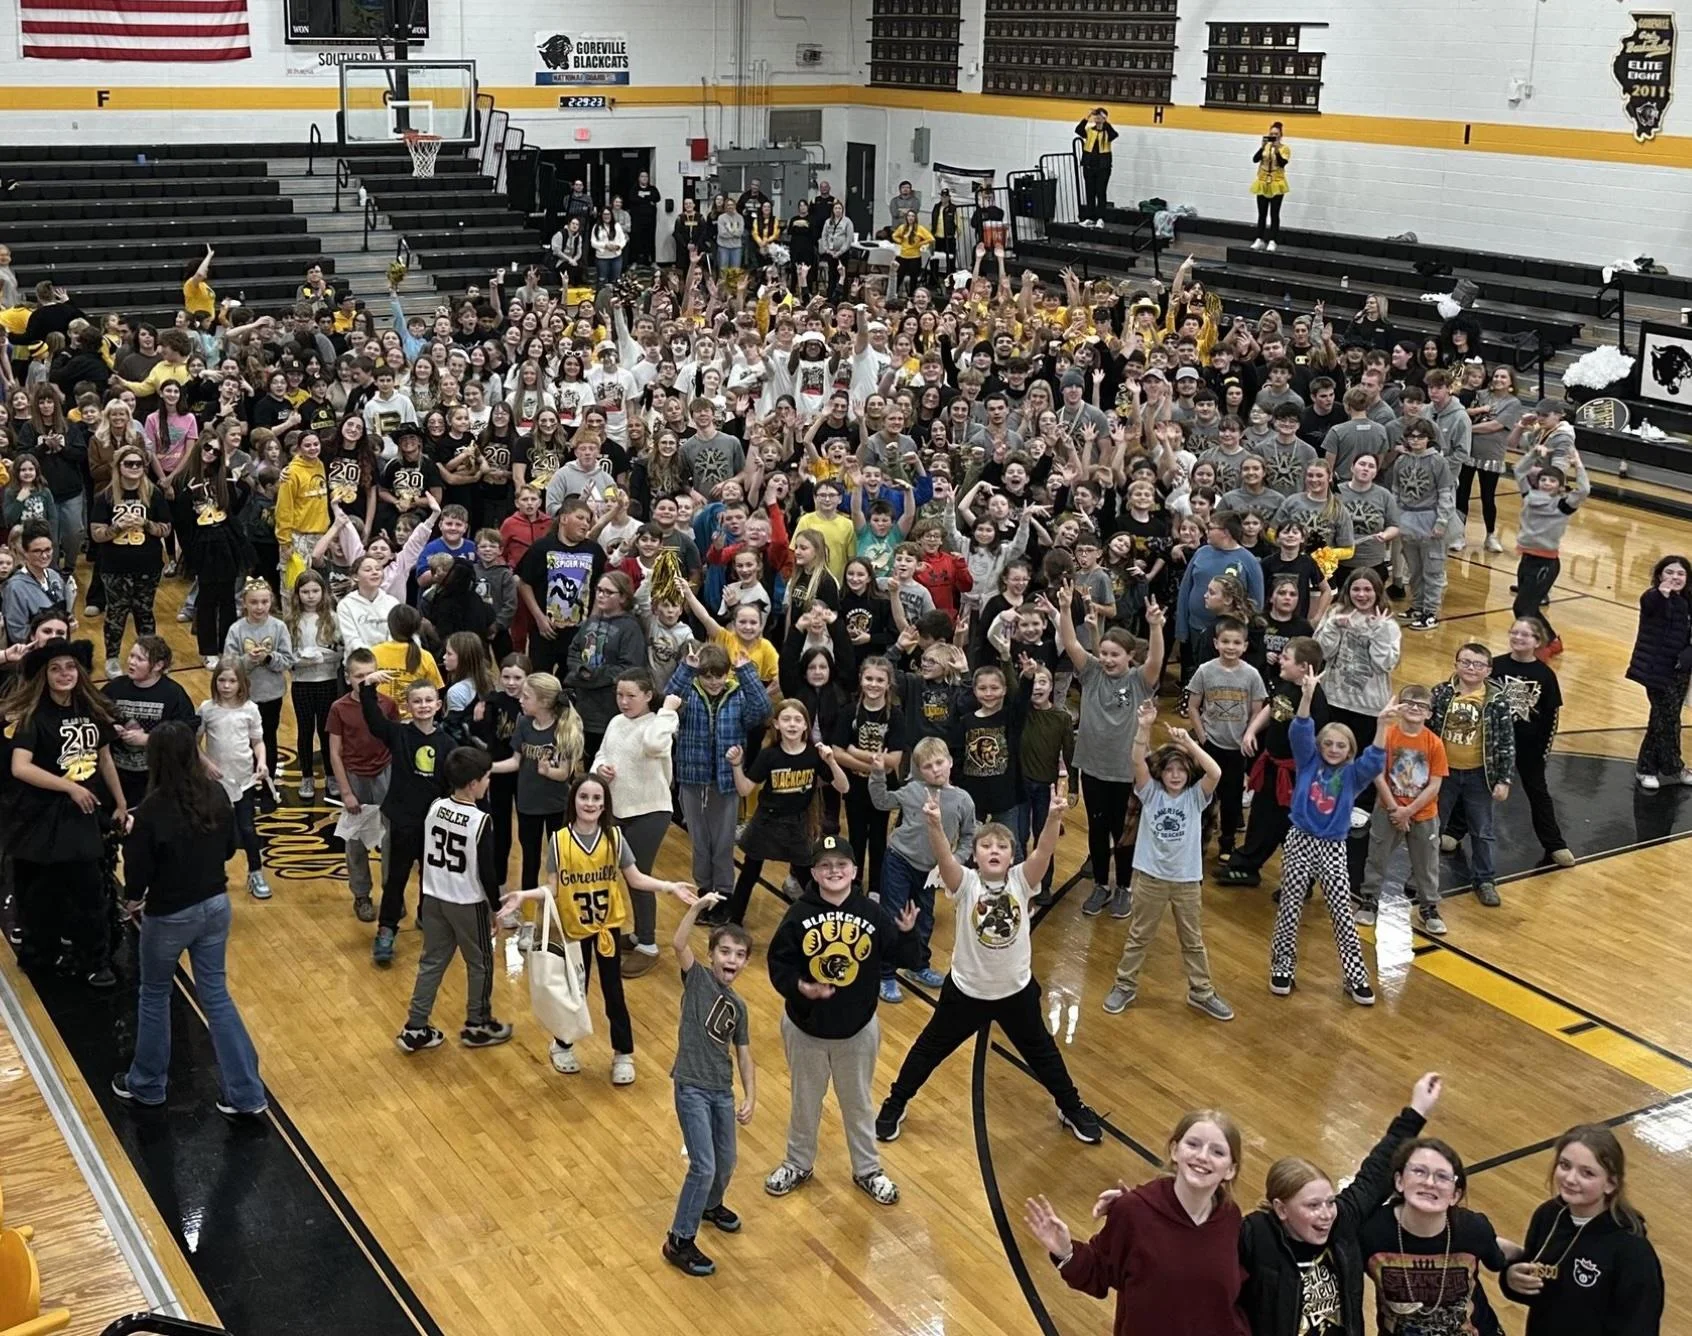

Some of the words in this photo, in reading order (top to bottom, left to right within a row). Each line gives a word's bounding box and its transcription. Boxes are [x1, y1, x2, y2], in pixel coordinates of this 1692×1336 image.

[293, 25, 309, 33] WON
[576, 41, 626, 54] GOREVILLE
[573, 55, 629, 68] BLACKCATS
[1627, 60, 1664, 70] ELITE
[1627, 71, 1662, 81] EIGHT
[97, 90, 110, 107] F
[1631, 84, 1666, 98] 2011
[1153, 106, 1164, 124] H
[485, 445, 511, 472] 20
[329, 461, 360, 484] 20
[394, 470, 424, 490] 20
[112, 503, 147, 525] 20
[60, 723, 100, 754] 20
[436, 806, 470, 828] ISSLER
[427, 825, 467, 874] 35
[824, 836, 836, 849] G
[560, 865, 617, 887] Goreville
[573, 889, 609, 924] 35
[802, 911, 876, 935] BLACKCATS
[705, 994, 736, 1045] G
